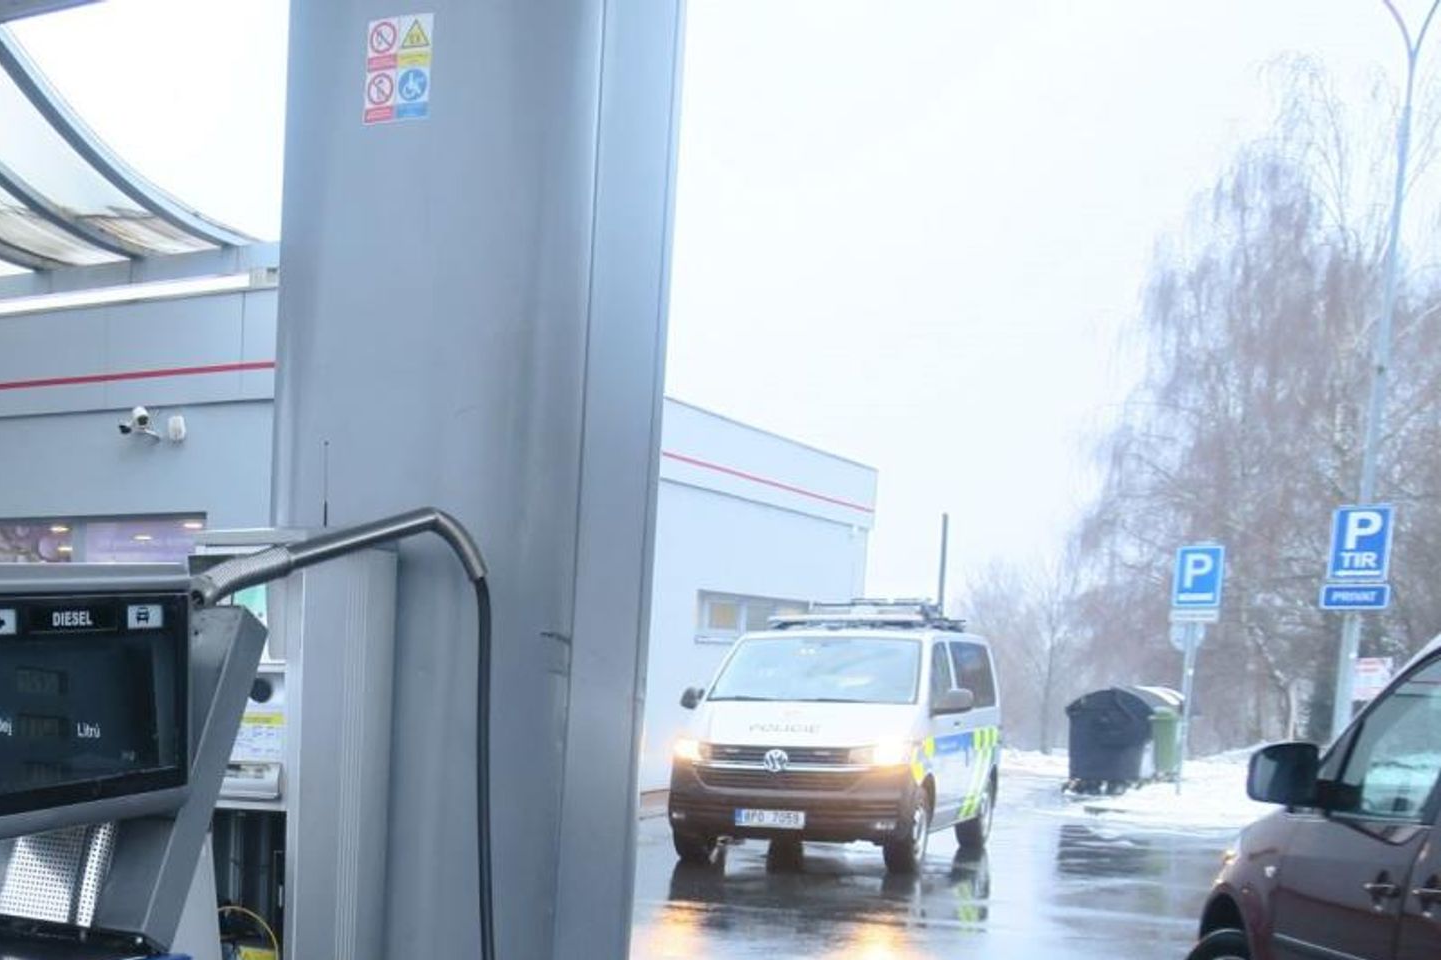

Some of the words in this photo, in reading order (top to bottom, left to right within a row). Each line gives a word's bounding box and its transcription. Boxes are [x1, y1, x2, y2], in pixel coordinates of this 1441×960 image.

[1344, 511, 1383, 550] P
[1182, 553, 1214, 588] P
[1340, 551, 1378, 568] TIR
[52, 610, 93, 627] DIESEL
